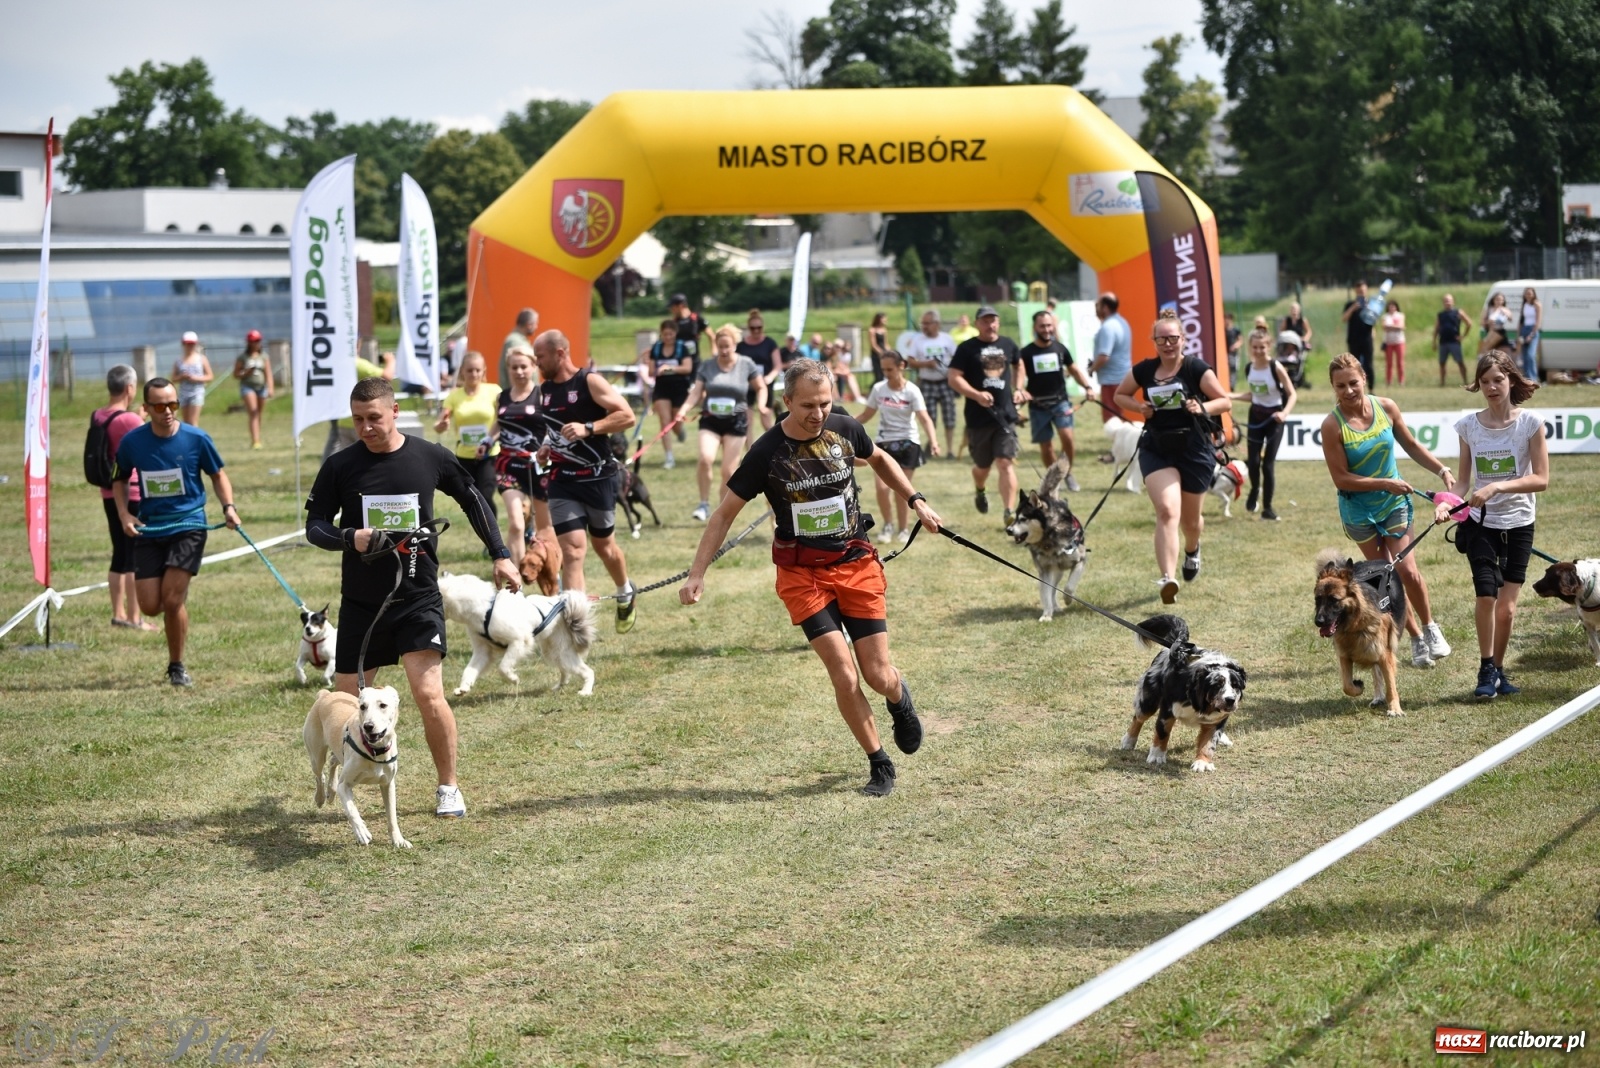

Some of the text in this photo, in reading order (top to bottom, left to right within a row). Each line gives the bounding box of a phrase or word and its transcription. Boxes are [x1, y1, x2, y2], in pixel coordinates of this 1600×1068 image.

[718, 136, 987, 168] MIASTO RACIBÓRZ
[305, 216, 335, 396] TropiDog
[1492, 461, 1499, 470] 6
[159, 483, 169, 492] 16
[786, 467, 852, 492] RUNMAGEDDON
[383, 515, 401, 526] 20
[814, 518, 829, 528] 18
[408, 546, 418, 578] power
